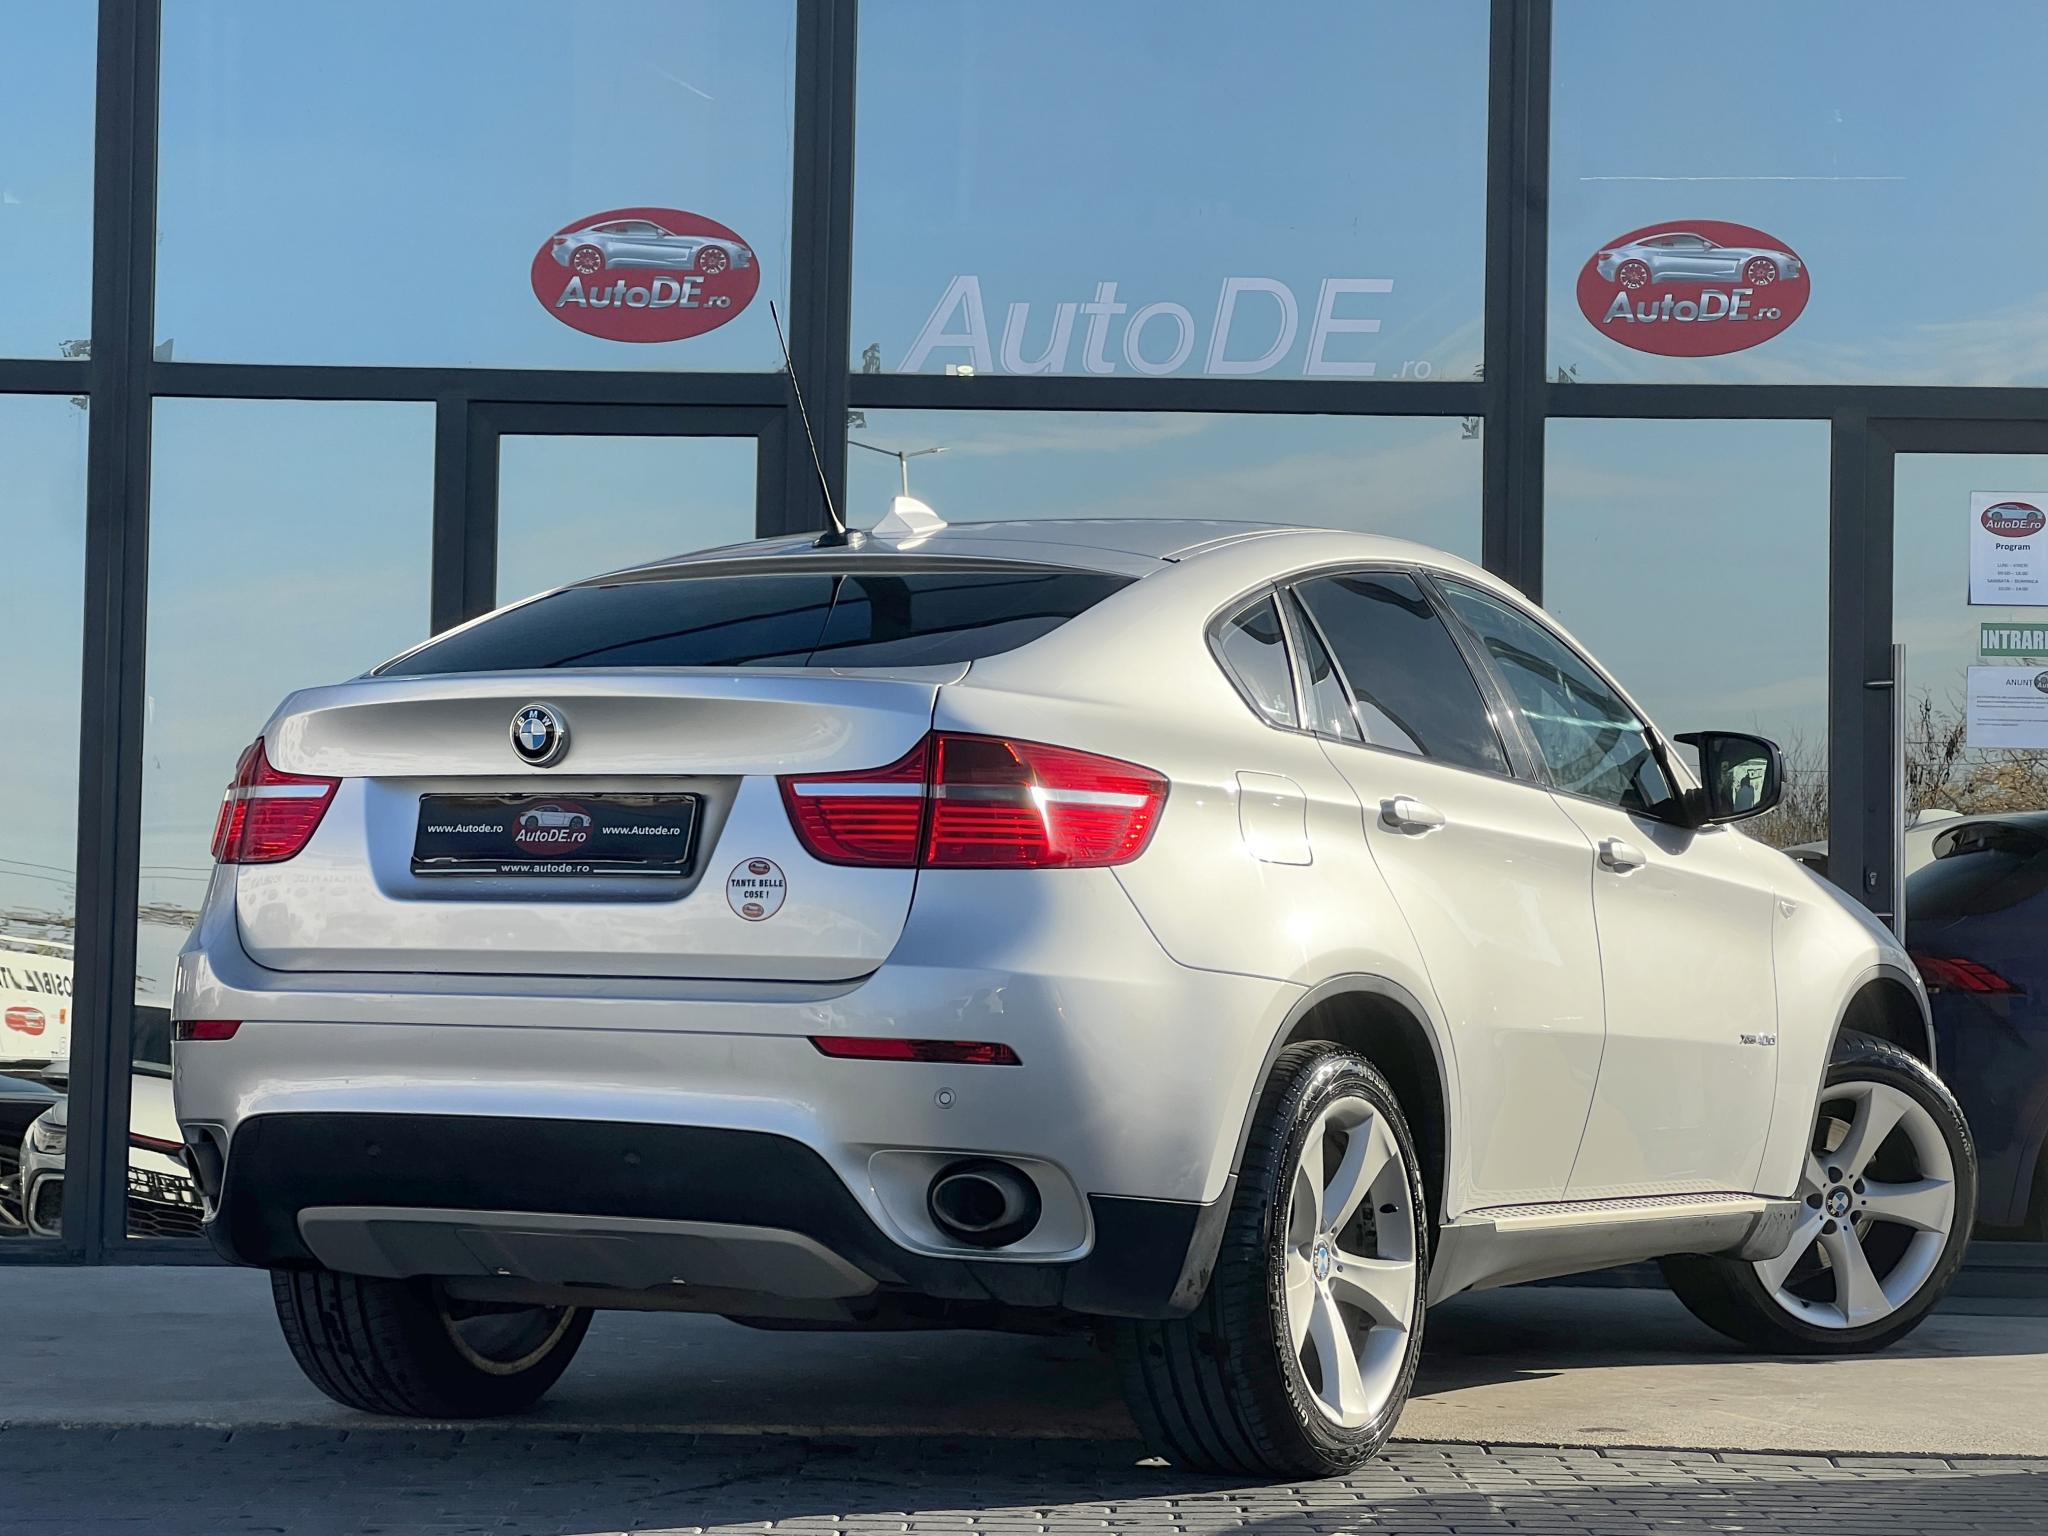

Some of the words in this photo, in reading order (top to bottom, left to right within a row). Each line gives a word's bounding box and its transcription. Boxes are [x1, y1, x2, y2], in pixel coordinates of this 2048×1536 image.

[1986, 519, 2041, 529] AutoDE.ro
[1995, 542, 2030, 551] Program
[517, 710, 551, 726] BMW
[427, 824, 504, 833] www.Autode.ro
[602, 825, 681, 835] www.Autode.ro
[515, 829, 587, 842] AutoDE.ro
[501, 863, 590, 873] www.autode.ro
[731, 879, 756, 887] TANTE
[759, 879, 783, 887] BELLE
[744, 890, 764, 899] COSE
